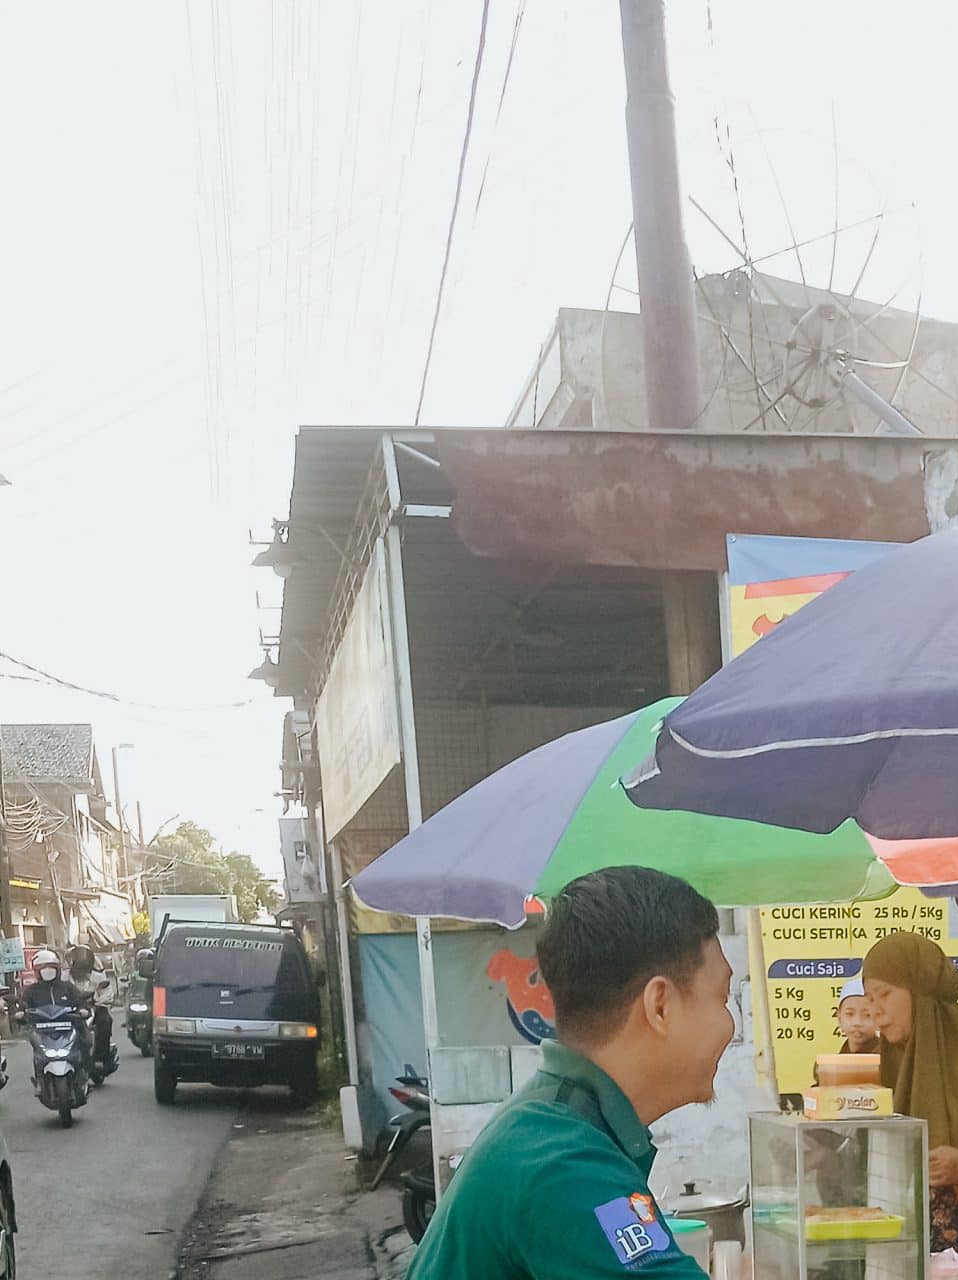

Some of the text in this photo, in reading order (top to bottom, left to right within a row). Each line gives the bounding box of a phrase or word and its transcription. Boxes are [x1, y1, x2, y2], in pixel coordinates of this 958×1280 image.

[771, 907, 805, 919] CUCI
[809, 907, 861, 919] KERING
[875, 907, 888, 918] 25
[892, 907, 908, 918] Rb
[920, 907, 943, 920] 5Kg
[773, 928, 806, 939] CUCI
[810, 927, 867, 939] SETRIKA
[875, 927, 887, 938] 21
[787, 961, 845, 977] Cuci Saja
[774, 987, 782, 998] 5
[786, 987, 804, 1000] Kg
[776, 1007, 789, 1019] 10
[793, 1007, 811, 1021] Kg
[776, 1028, 792, 1039] 20
[797, 1027, 814, 1040] Kg
[615, 1223, 653, 1259] iB
